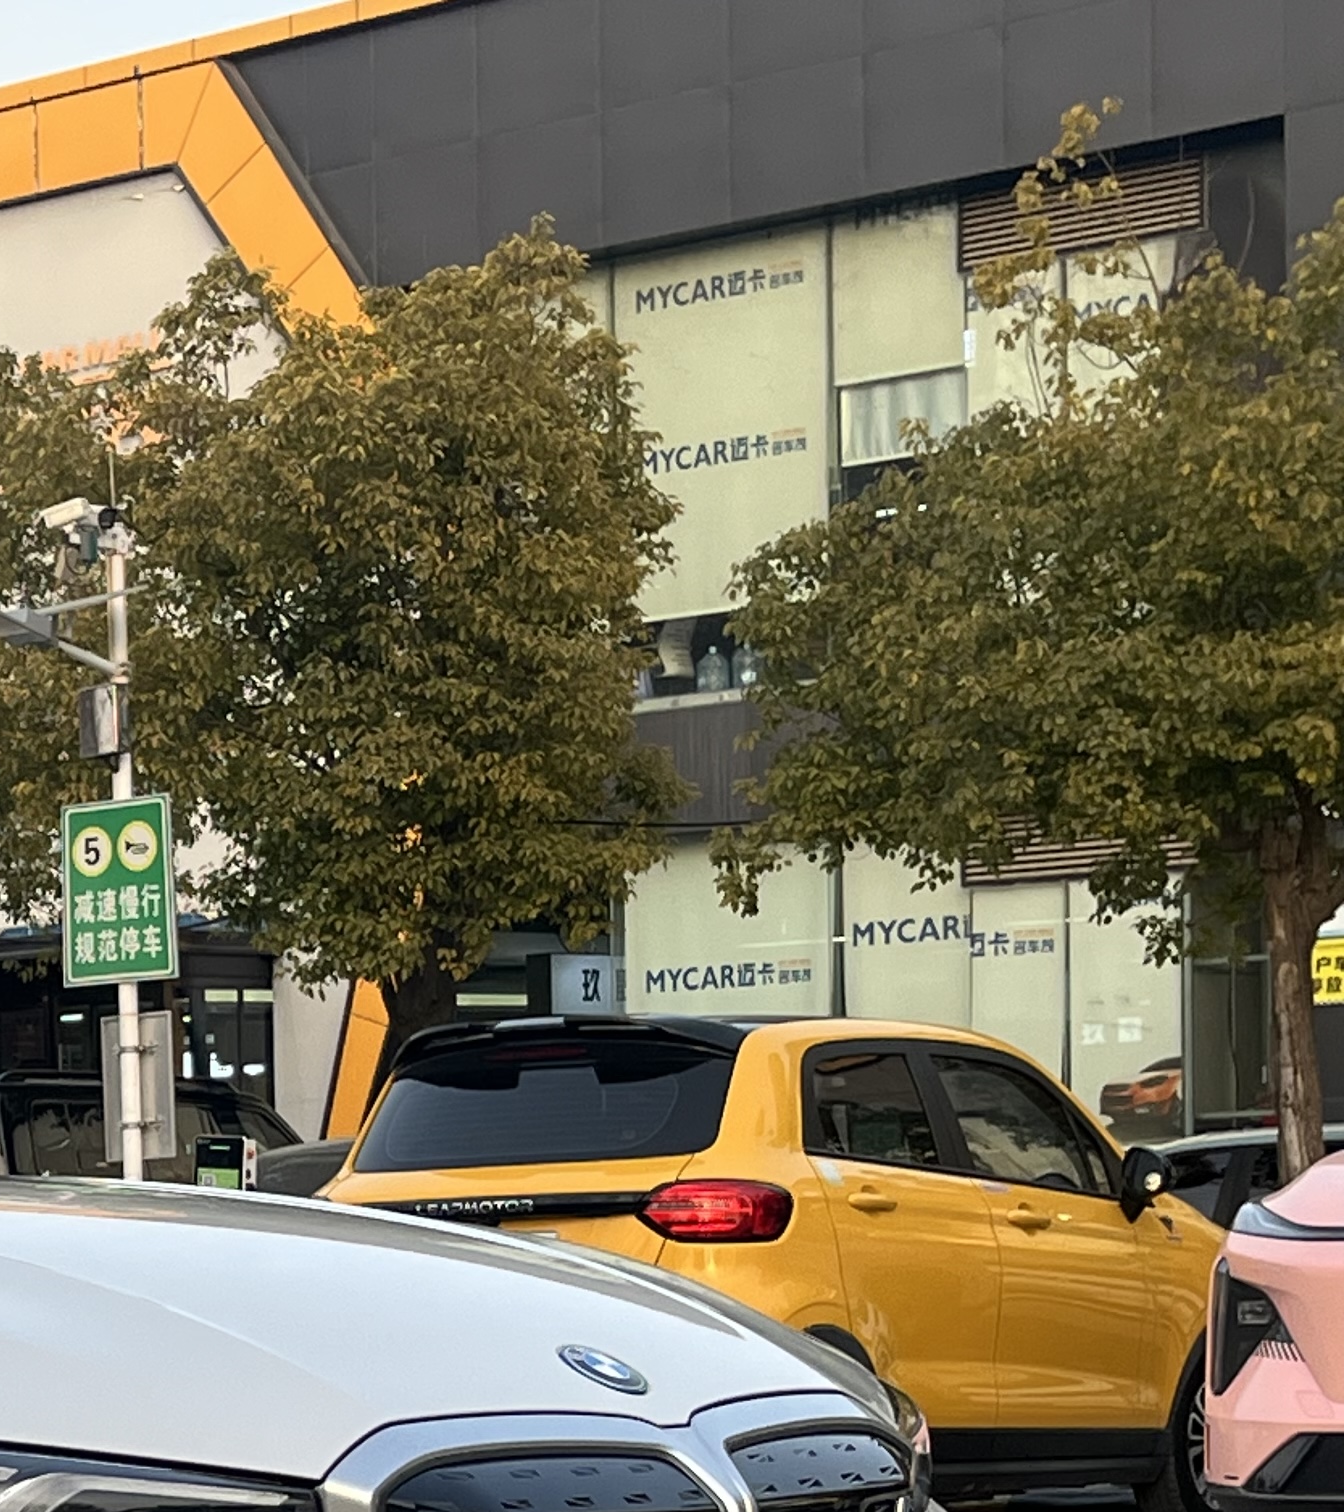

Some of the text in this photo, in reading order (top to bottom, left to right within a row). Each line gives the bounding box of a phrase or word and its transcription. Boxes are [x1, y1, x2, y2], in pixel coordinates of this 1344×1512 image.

[84, 836, 100, 866] 5
[74, 883, 161, 924] 减速慢行
[74, 925, 162, 964] 规范停车
